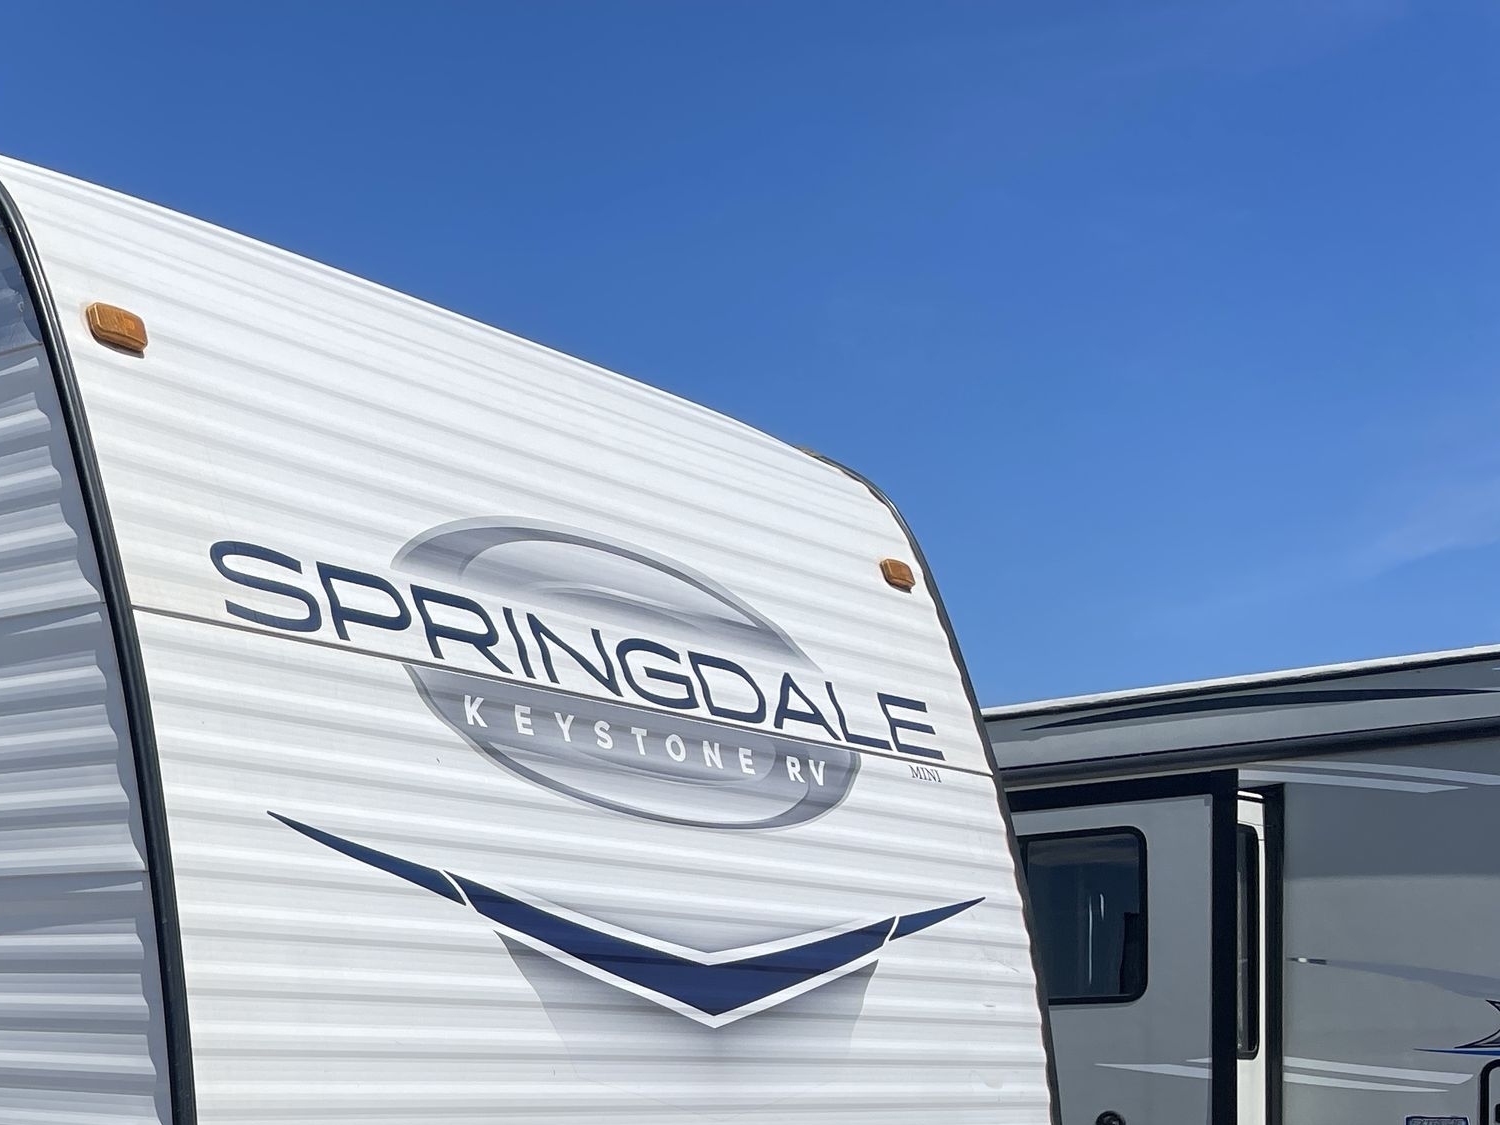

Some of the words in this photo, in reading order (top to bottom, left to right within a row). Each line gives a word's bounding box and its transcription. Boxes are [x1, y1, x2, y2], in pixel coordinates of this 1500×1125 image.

[209, 540, 947, 762] SPRINGDALE
[463, 694, 757, 776] KEYSTONE
[785, 754, 827, 787] RV
[908, 764, 943, 784] MINI
